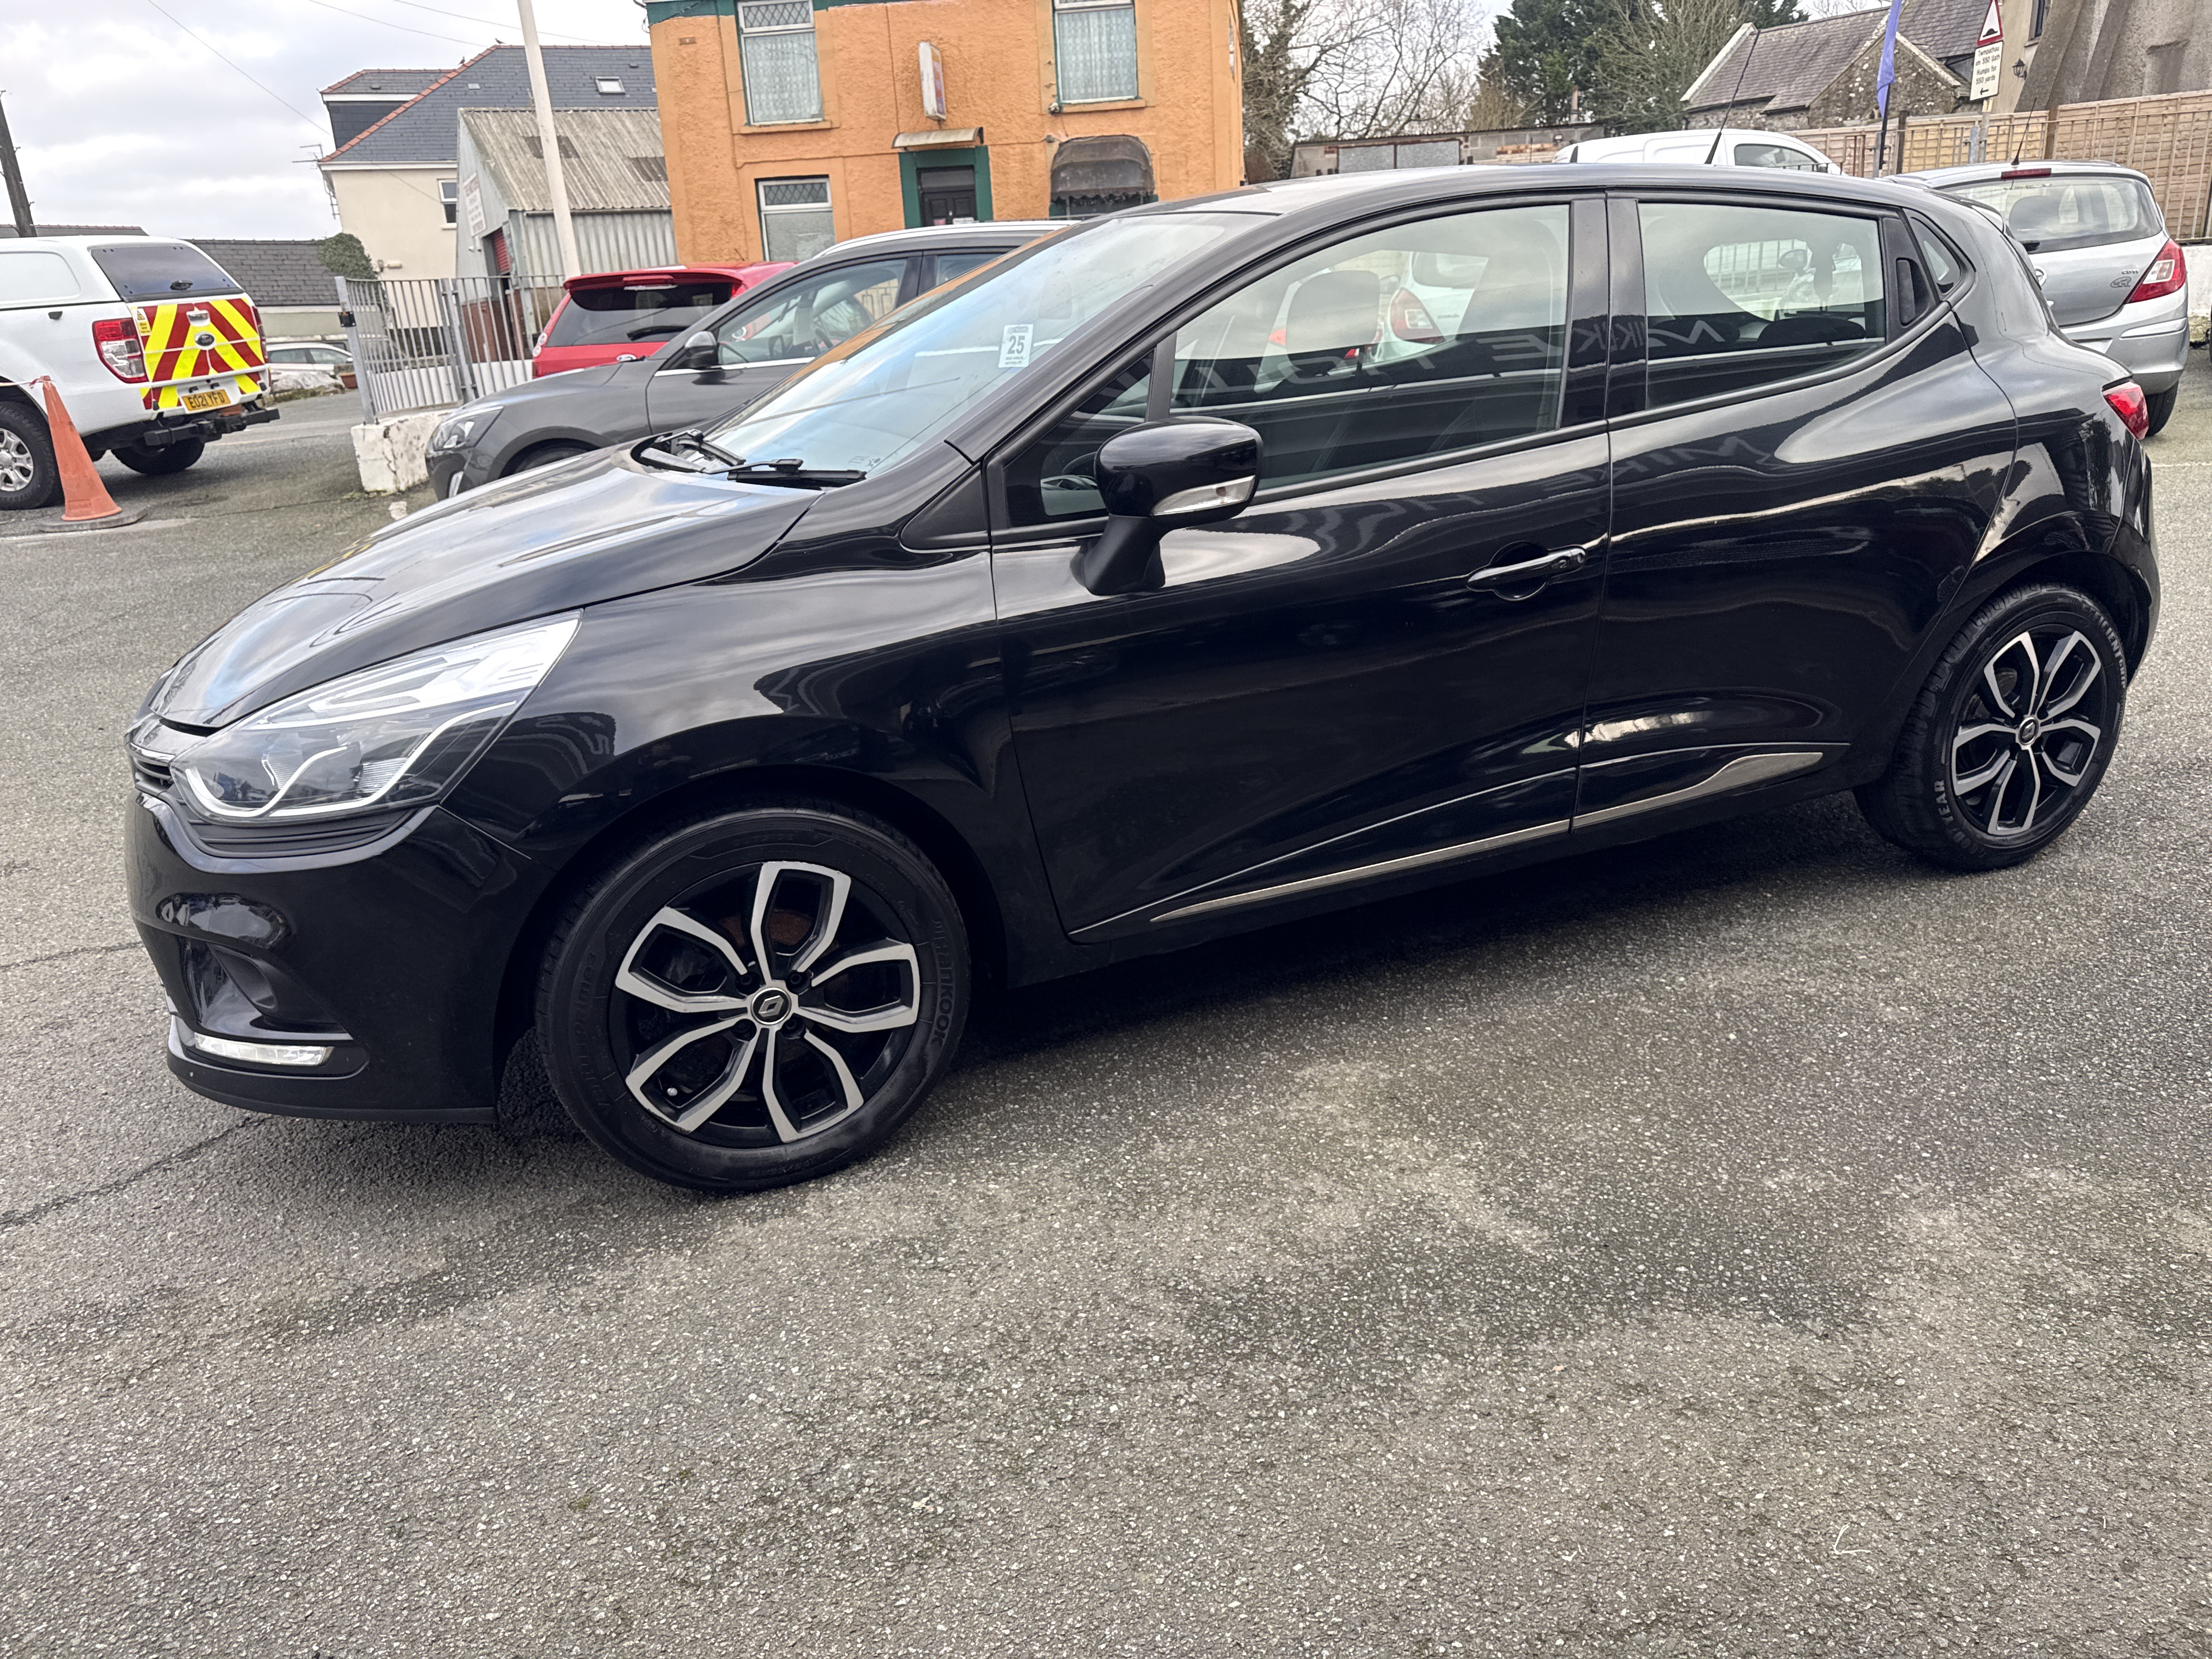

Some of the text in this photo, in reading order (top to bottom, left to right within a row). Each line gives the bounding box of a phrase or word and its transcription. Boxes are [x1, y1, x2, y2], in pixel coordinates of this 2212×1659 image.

[1982, 56, 1990, 64] 550
[1977, 67, 1990, 76] Humps
[1985, 74, 1996, 83] yards
[1007, 335, 1025, 354] 25
